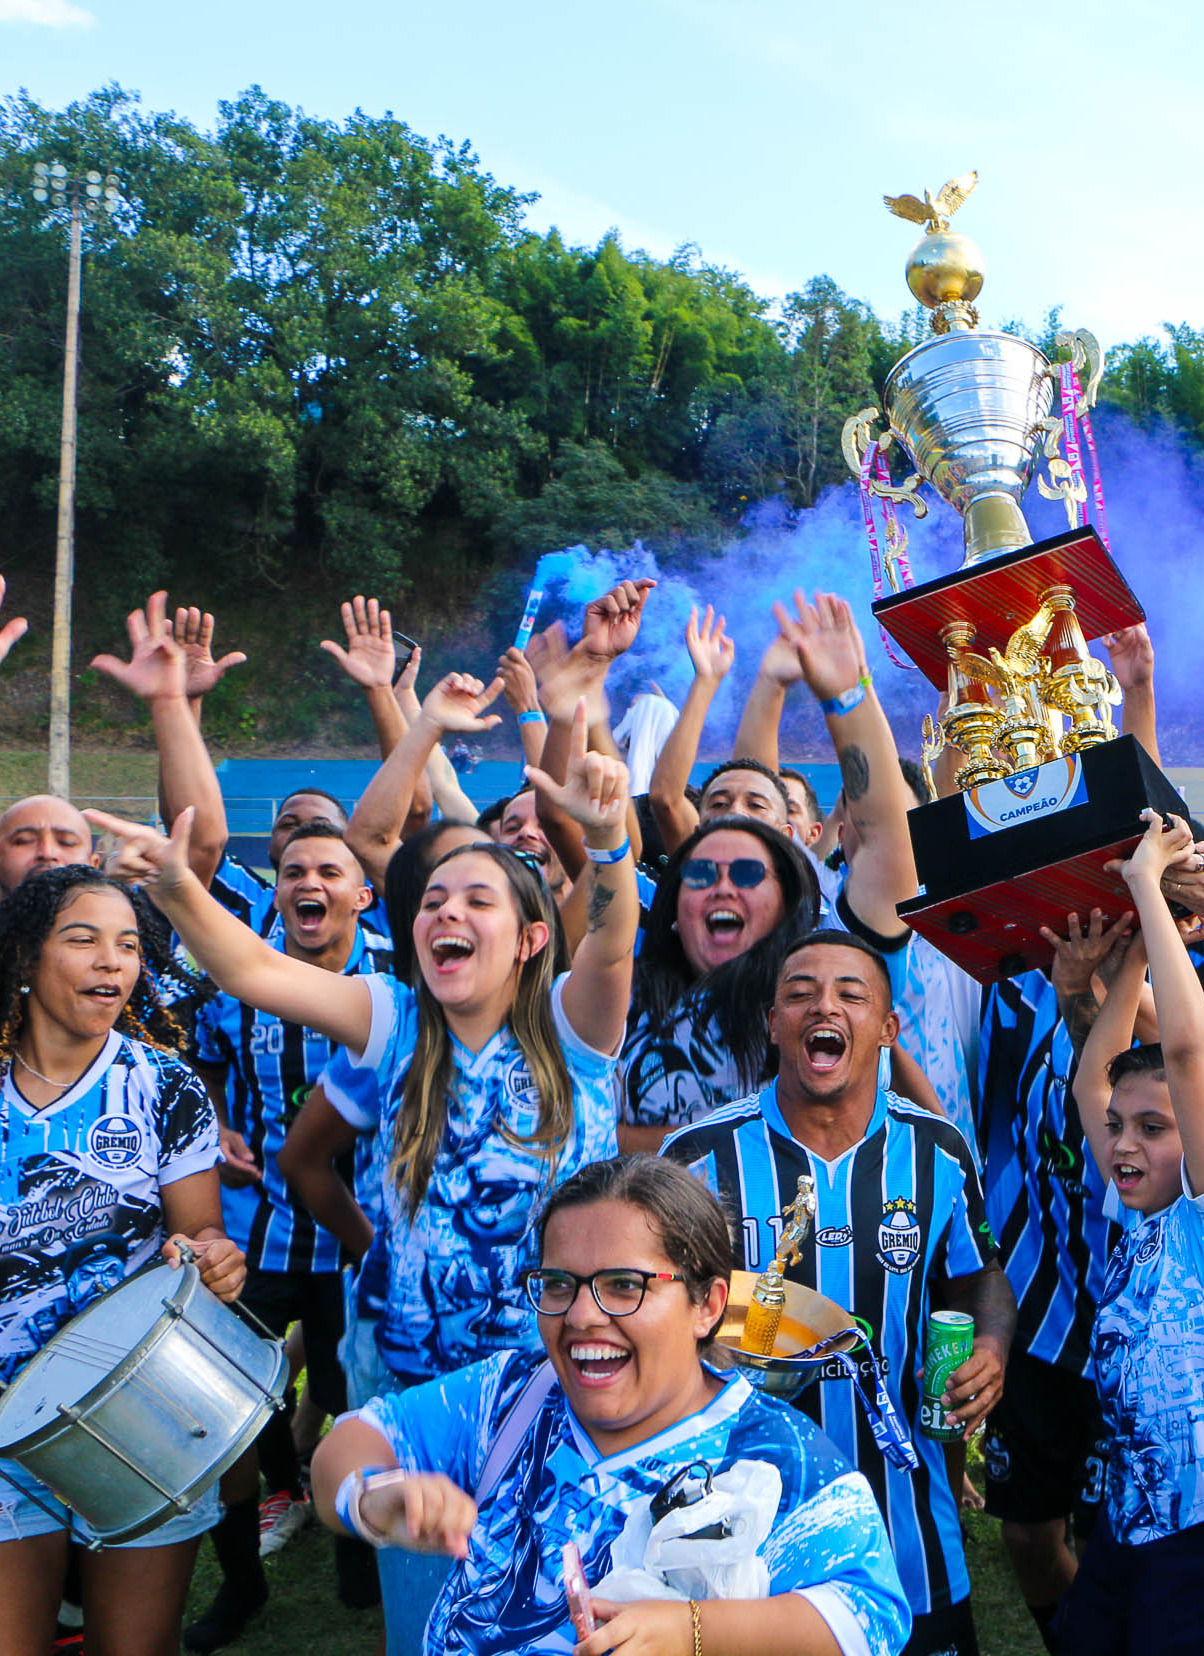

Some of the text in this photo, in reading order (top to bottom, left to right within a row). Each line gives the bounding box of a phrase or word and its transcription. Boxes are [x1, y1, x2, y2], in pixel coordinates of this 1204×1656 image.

[999, 797, 1058, 822] CAMPEÃO
[249, 1024, 284, 1054] 20
[881, 1231, 918, 1251] GRÊMIO
